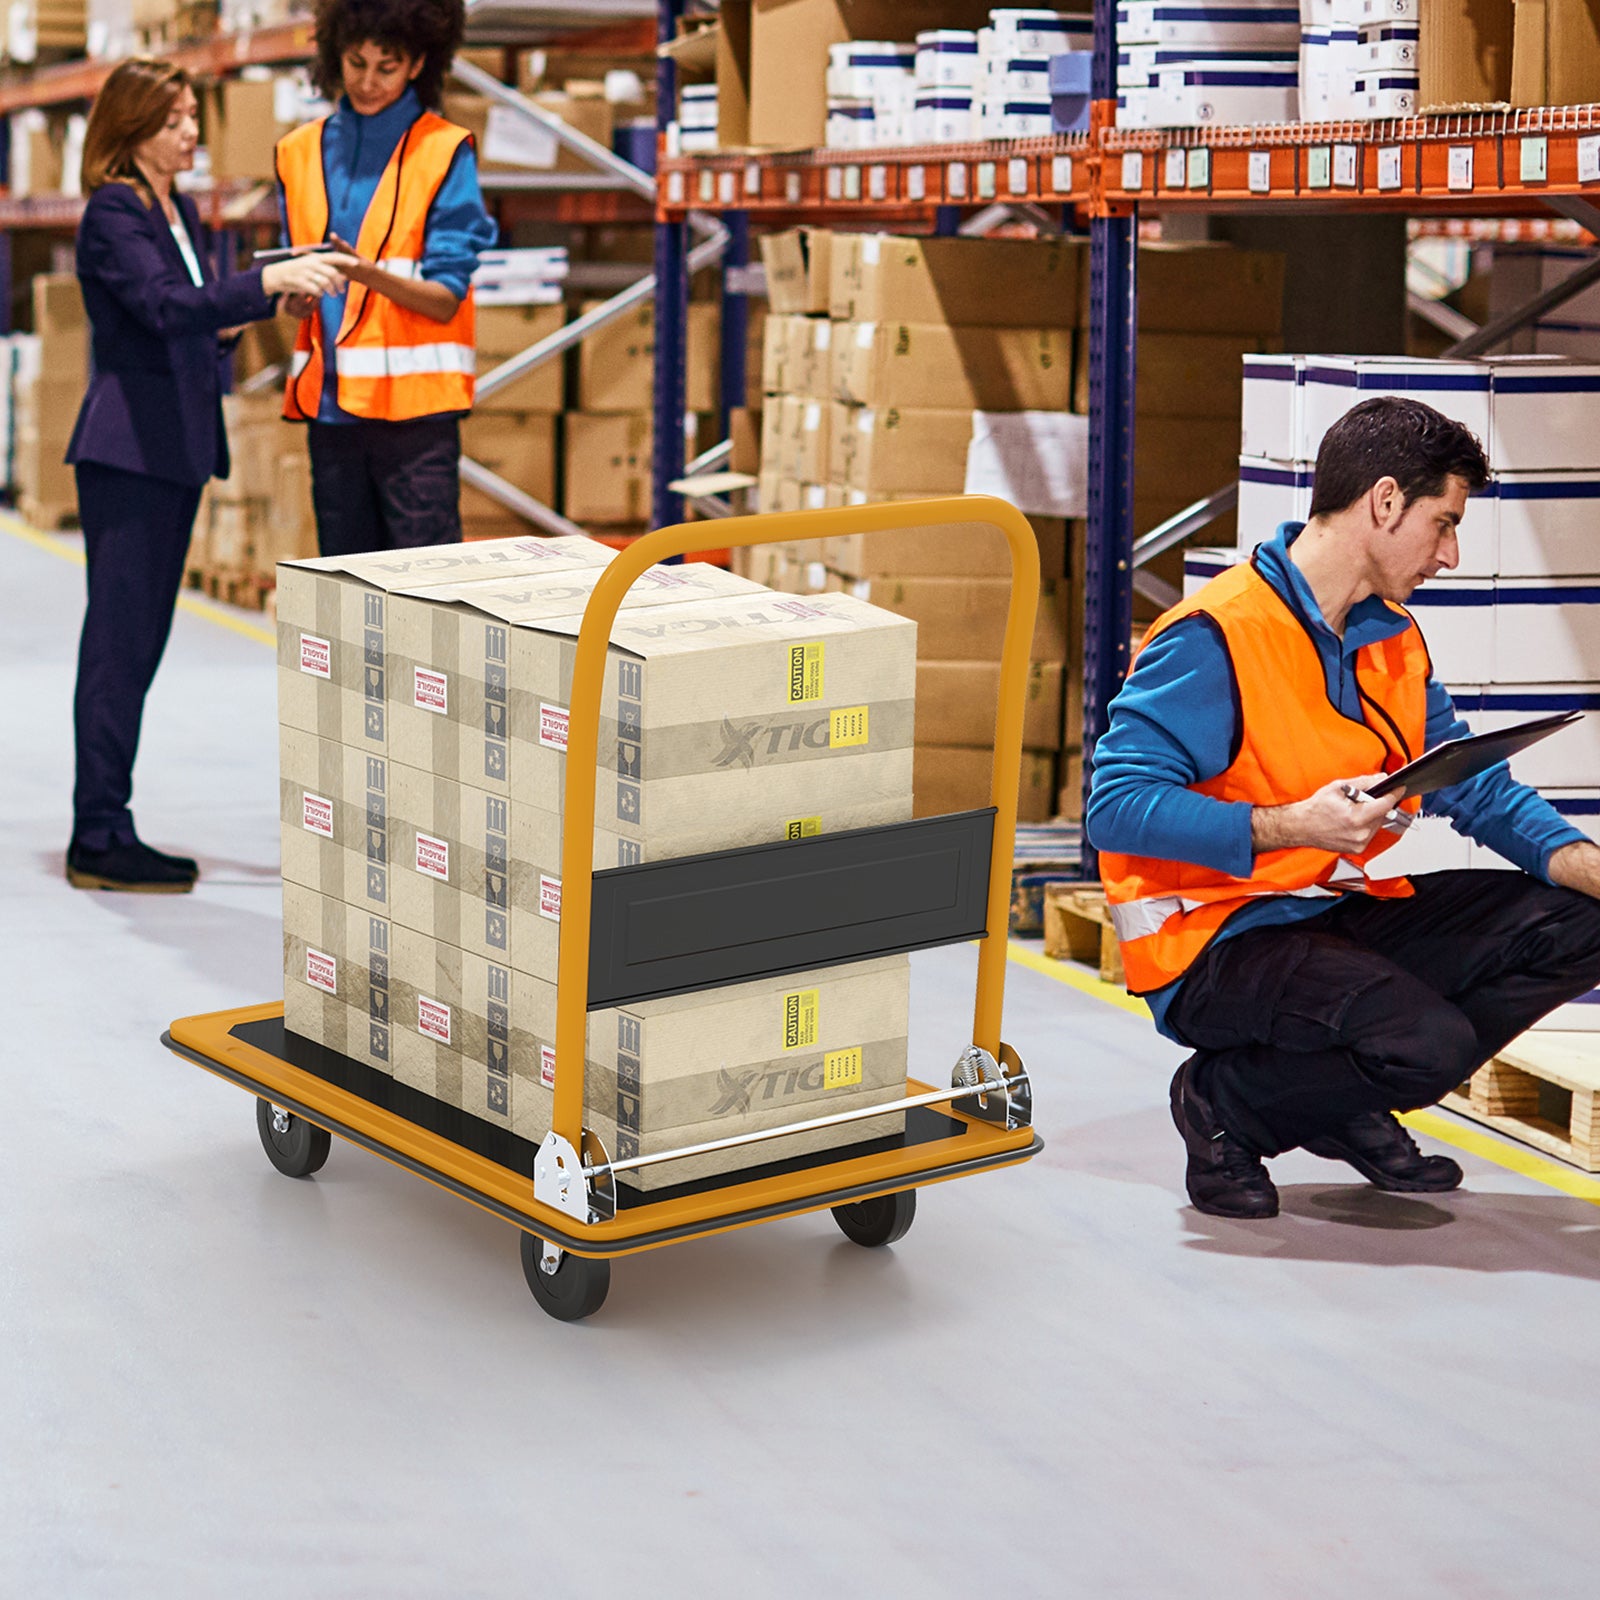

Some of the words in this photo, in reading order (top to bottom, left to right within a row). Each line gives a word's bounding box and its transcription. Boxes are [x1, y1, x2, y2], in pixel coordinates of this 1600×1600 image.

[302, 646, 328, 660] FRAGILE
[792, 648, 803, 699] CAUTION
[417, 680, 444, 695] FRAGILE
[542, 717, 569, 732] RAGILE
[305, 804, 331, 819] FRAGILE
[418, 845, 446, 862] FRAGILE
[308, 960, 334, 978] FRAGILE
[420, 1007, 448, 1026] FRAGILE
[787, 996, 798, 1046] CAUTION
